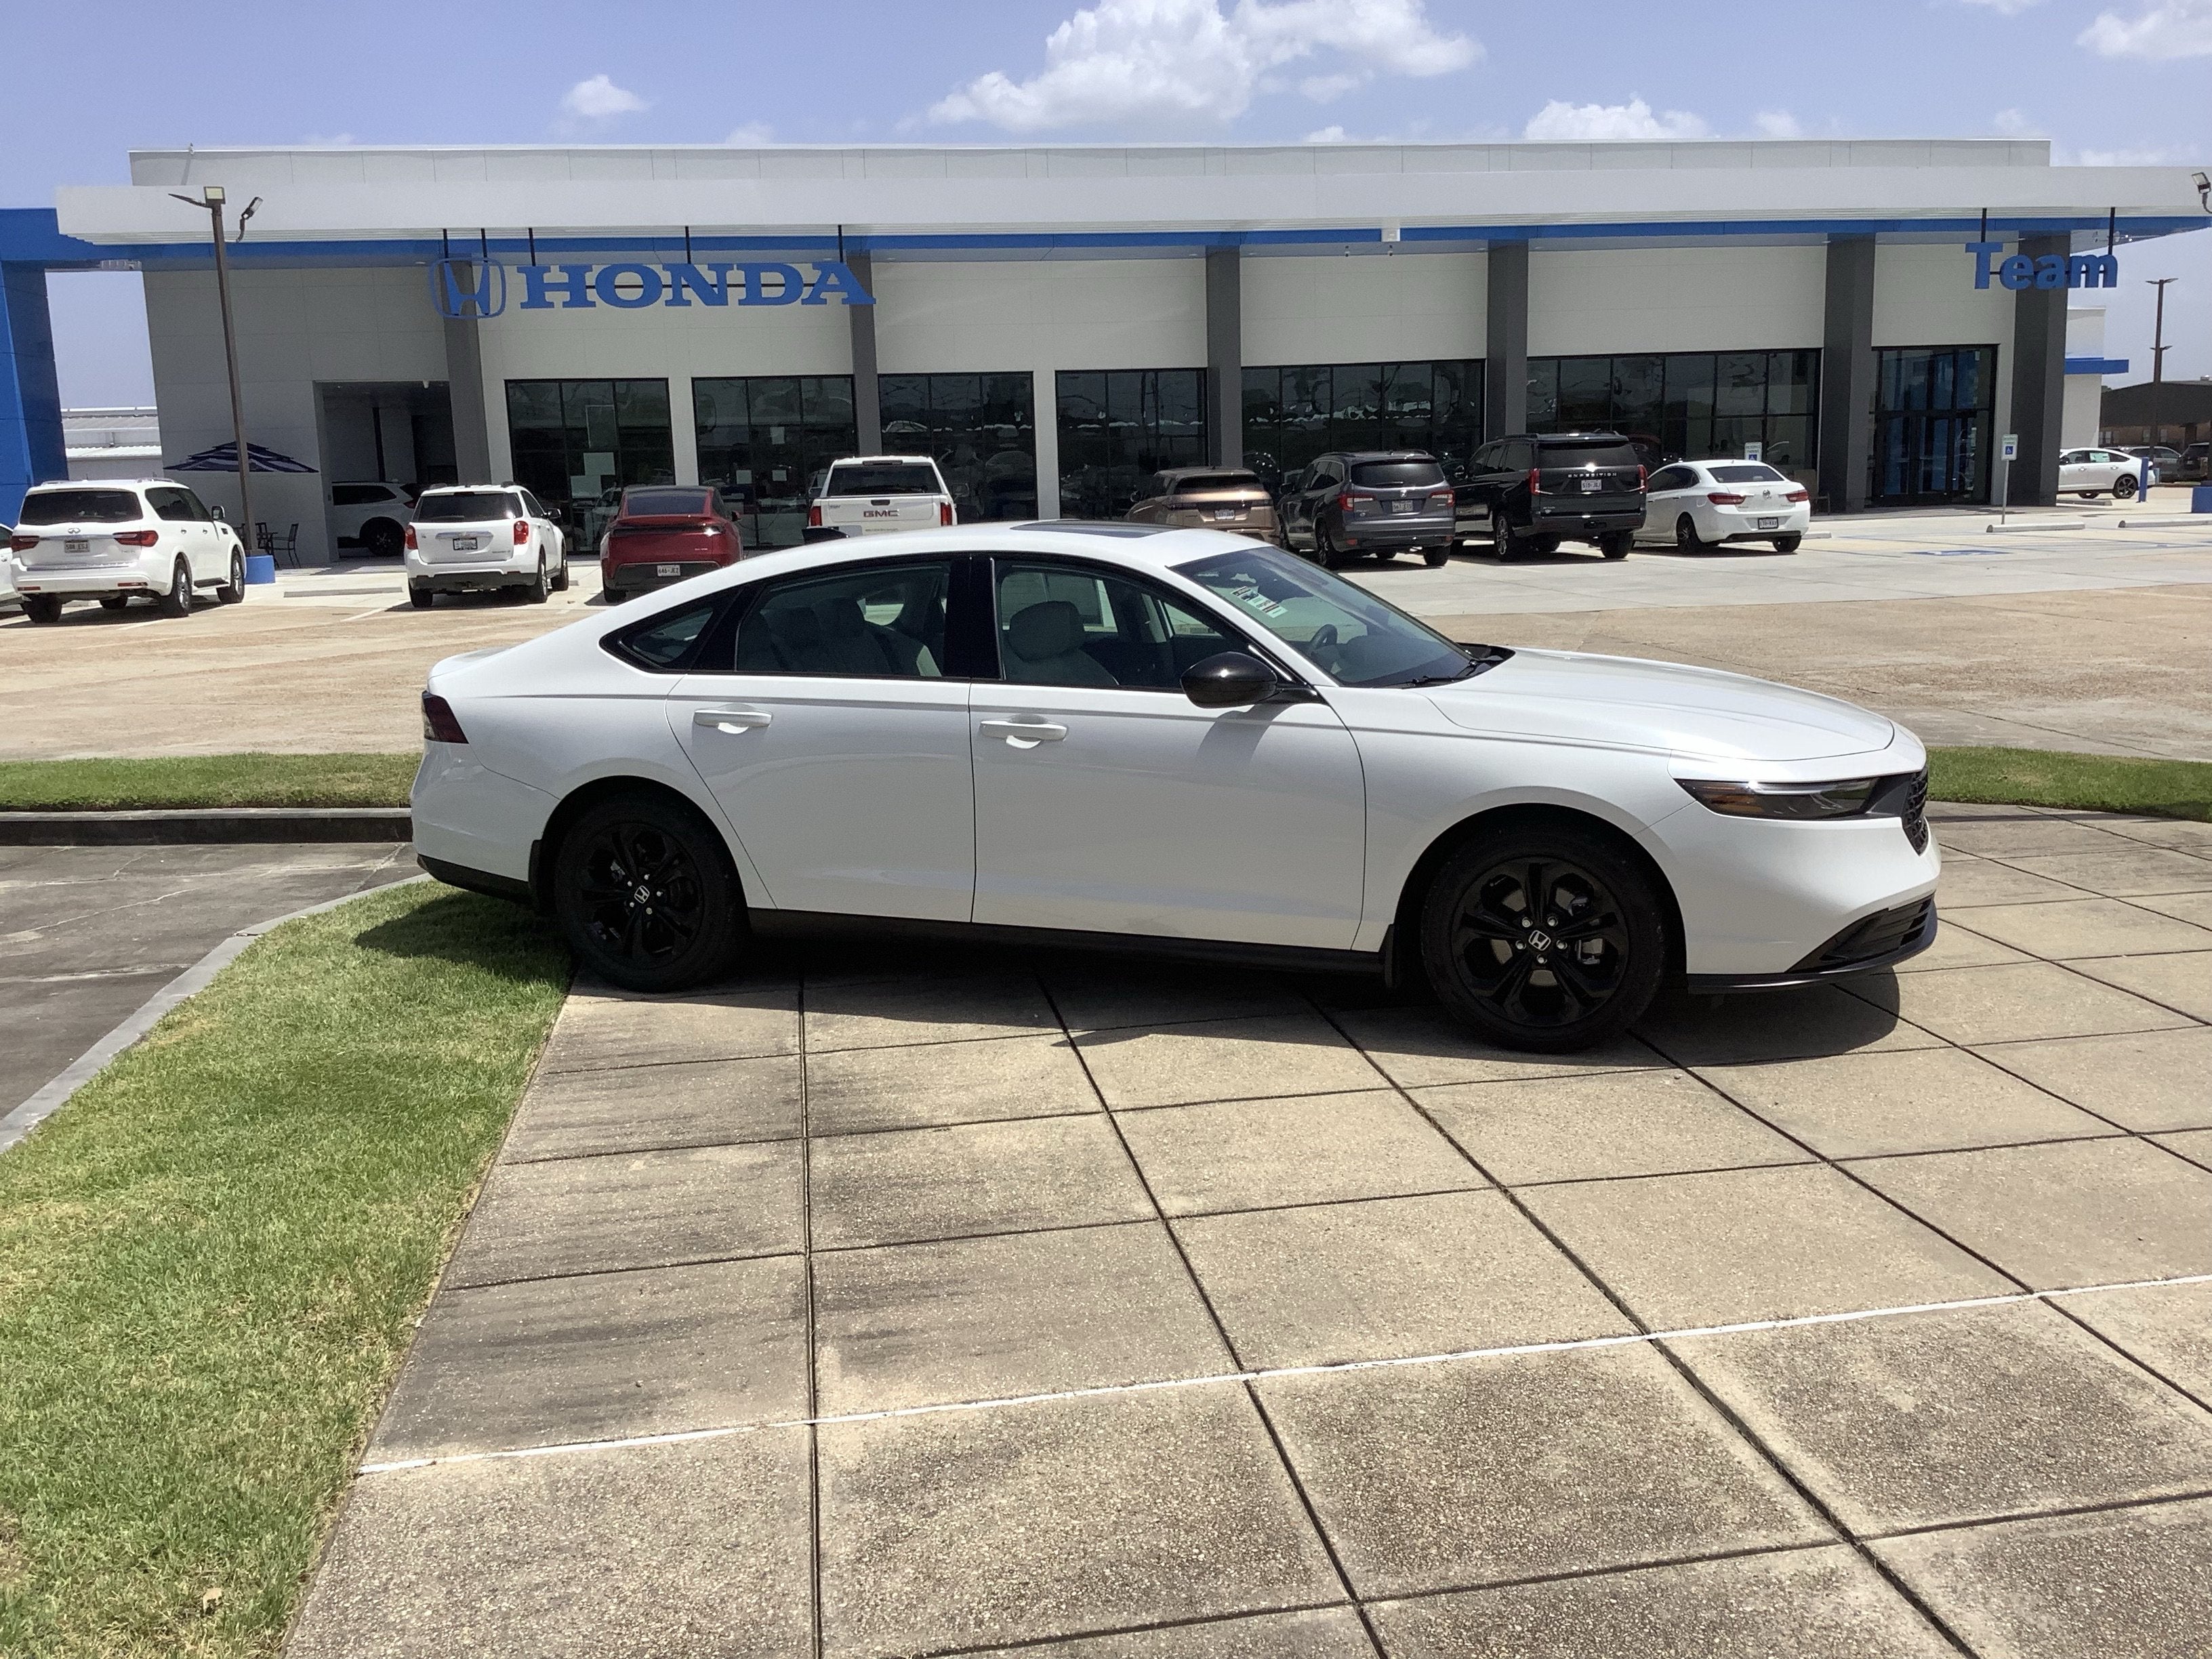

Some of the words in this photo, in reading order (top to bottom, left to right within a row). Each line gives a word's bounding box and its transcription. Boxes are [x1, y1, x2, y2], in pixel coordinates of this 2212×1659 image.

[516, 262, 876, 310] HONDA
[1965, 243, 2118, 290] Team
[863, 509, 900, 518] GMC
